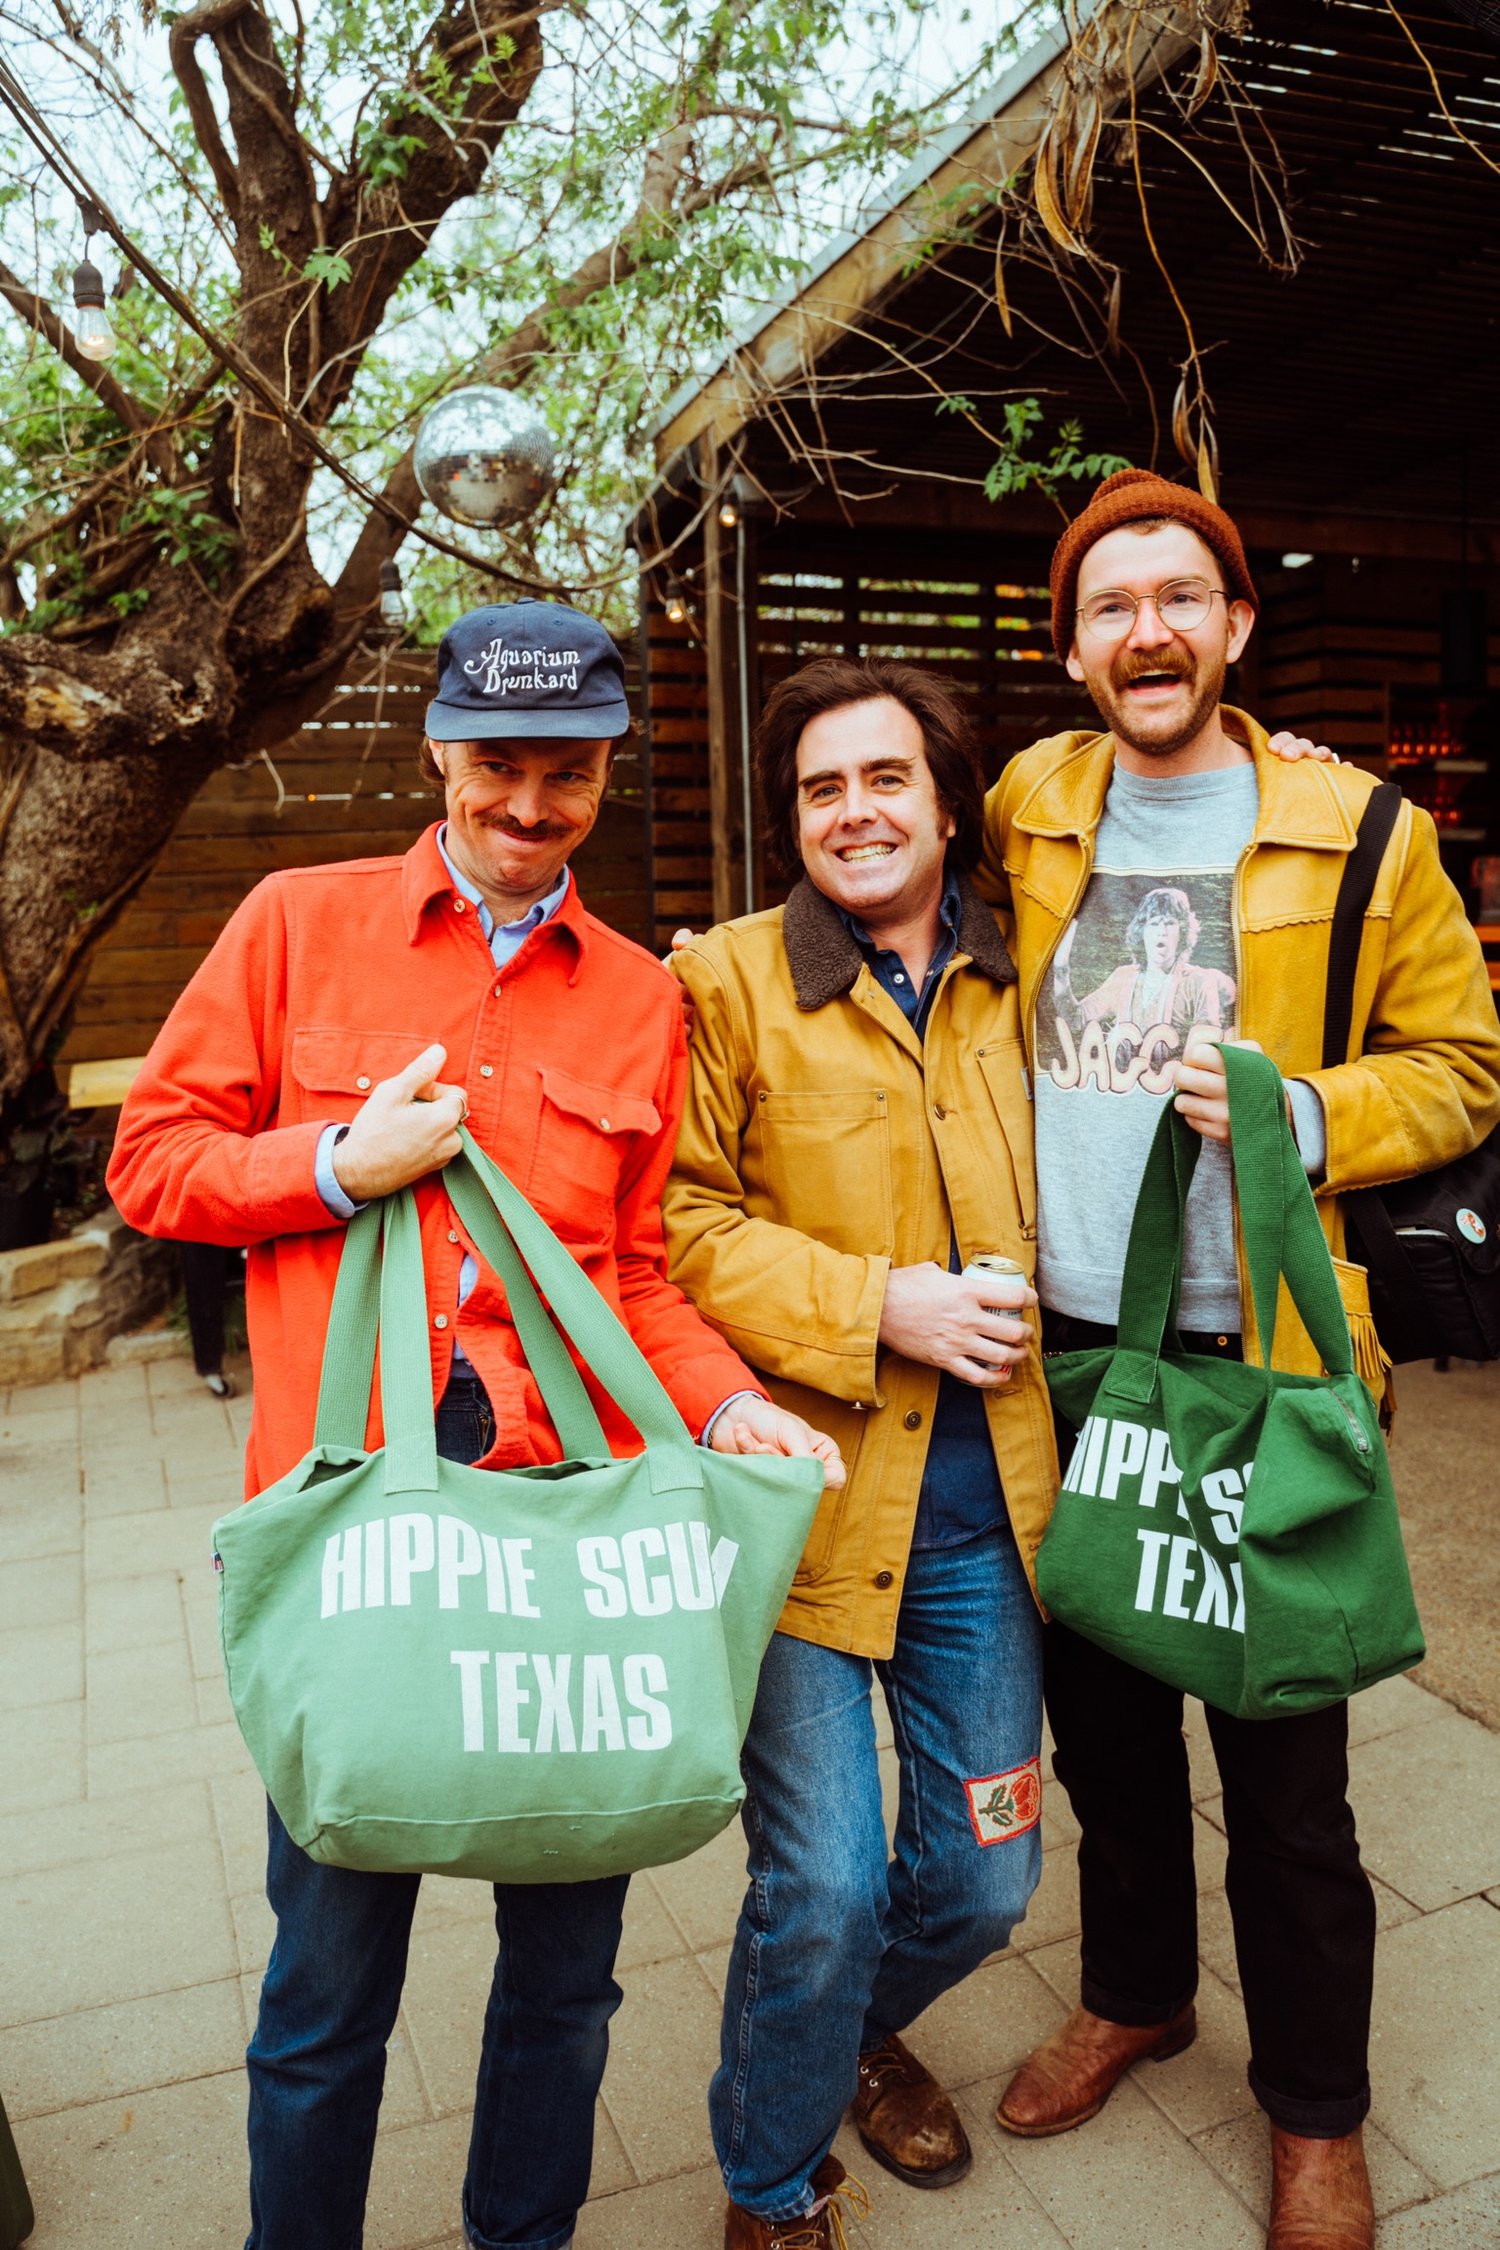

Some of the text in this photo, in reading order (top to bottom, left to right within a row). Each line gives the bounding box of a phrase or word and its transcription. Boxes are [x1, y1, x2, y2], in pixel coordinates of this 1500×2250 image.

[464, 638, 580, 673] Aquarium
[483, 667, 577, 695] Drunkard
[1202, 1462, 1253, 1544] S
[321, 1514, 540, 1619] HIPPIE
[451, 1651, 672, 1752] TEXAS
